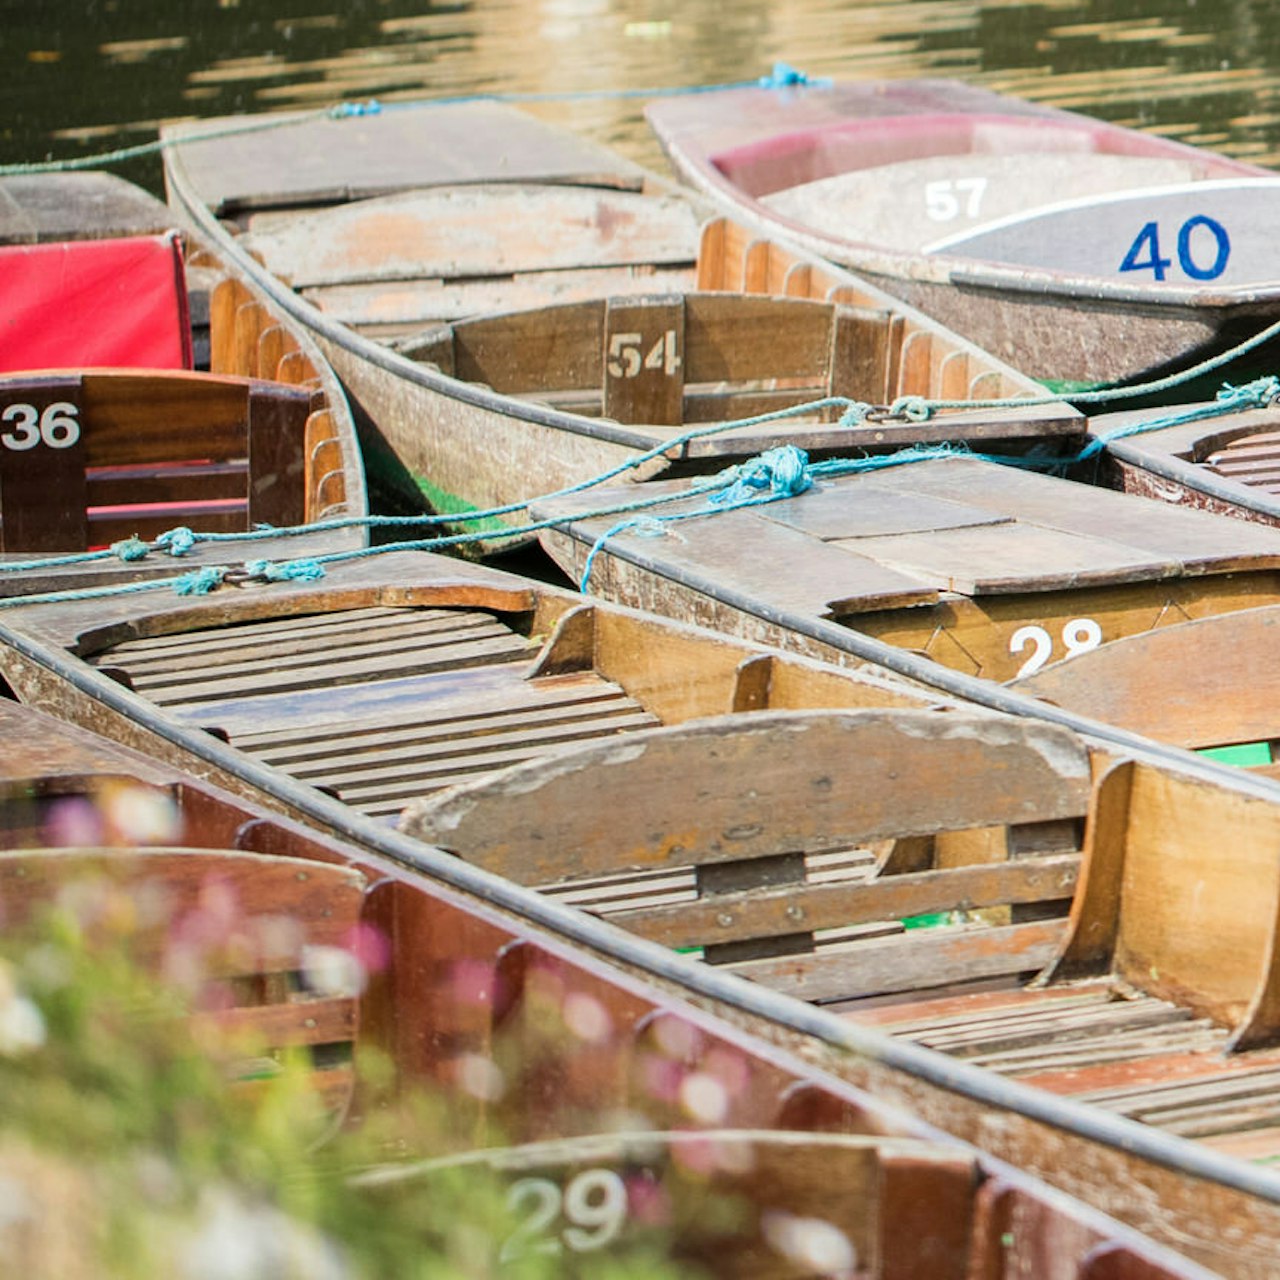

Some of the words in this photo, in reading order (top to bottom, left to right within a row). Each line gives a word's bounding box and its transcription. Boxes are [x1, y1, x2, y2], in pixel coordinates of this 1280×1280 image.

[926, 177, 987, 222] 57
[1120, 214, 1231, 281] 40
[608, 330, 681, 379] 54
[1, 402, 80, 451] 36
[499, 1168, 628, 1263] 29
